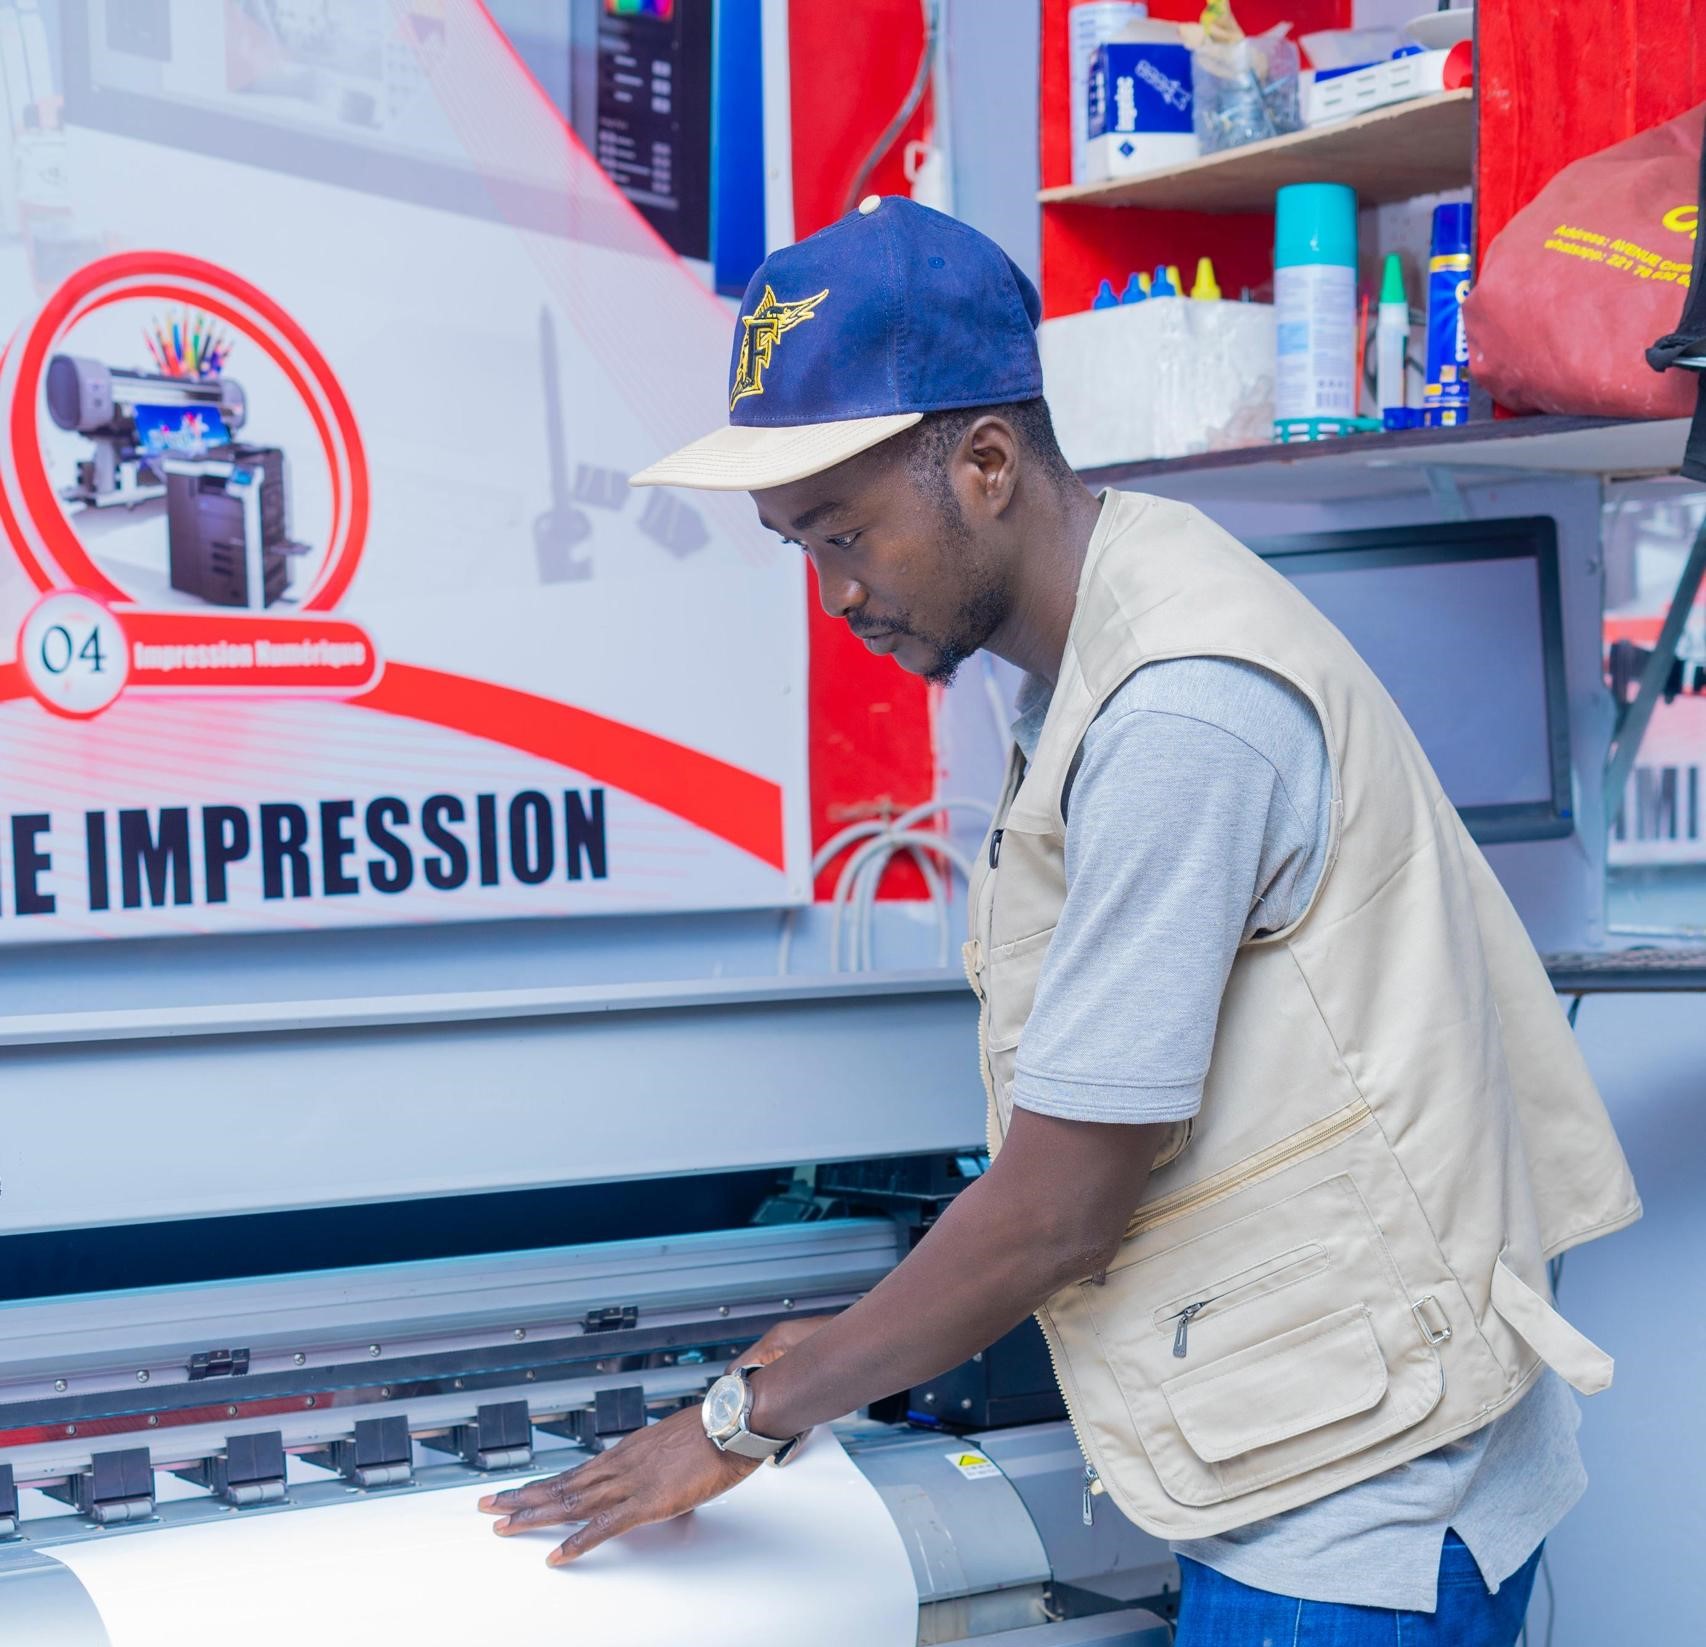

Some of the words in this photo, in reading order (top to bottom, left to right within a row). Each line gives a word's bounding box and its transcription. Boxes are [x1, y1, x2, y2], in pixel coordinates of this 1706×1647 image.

[1609, 239, 1663, 267] AVENUE
[41, 625, 106, 674] 04
[133, 640, 253, 672] Impression
[254, 638, 366, 669] Numérique
[0, 813, 56, 918] E
[85, 788, 608, 912] IMPRESSION
